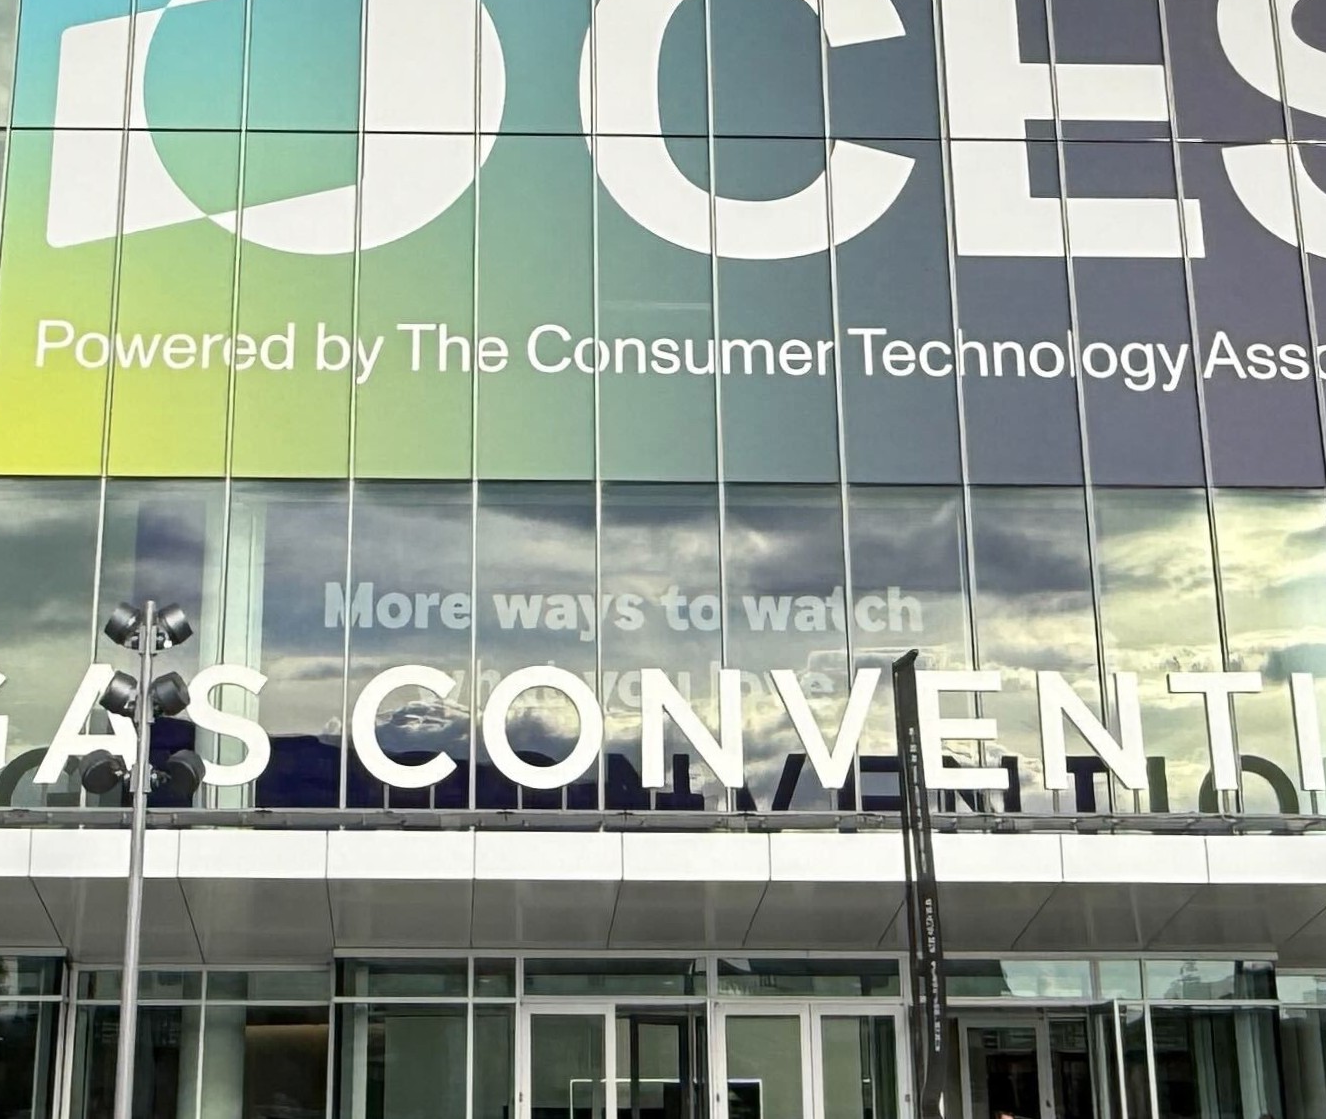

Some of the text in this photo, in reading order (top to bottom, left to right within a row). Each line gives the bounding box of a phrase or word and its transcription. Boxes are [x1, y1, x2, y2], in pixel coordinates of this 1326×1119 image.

[35, 320, 295, 370] Powered
[315, 322, 385, 384] by
[396, 322, 509, 372] The
[527, 323, 833, 376] Consumer
[848, 328, 1188, 392] Technology
[324, 582, 925, 642] More ways to watch
